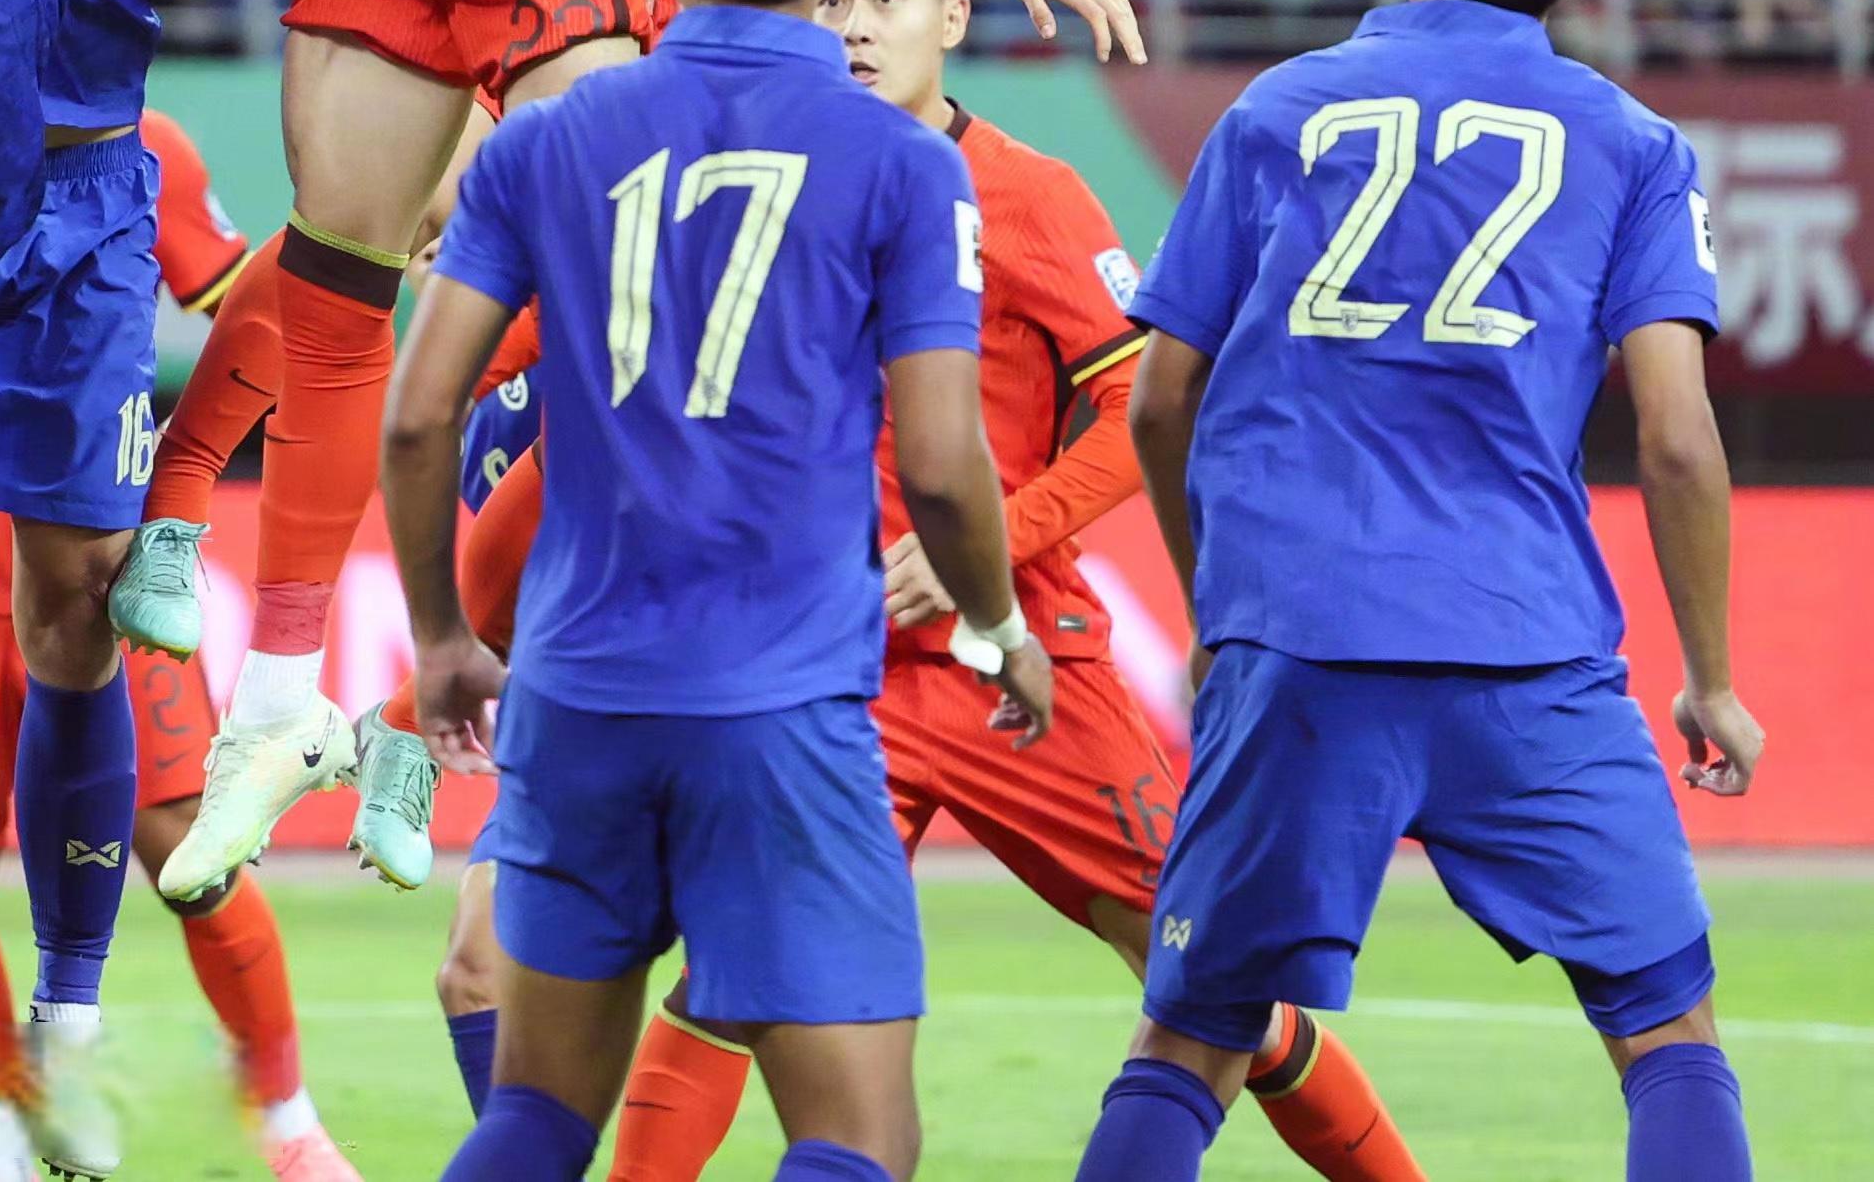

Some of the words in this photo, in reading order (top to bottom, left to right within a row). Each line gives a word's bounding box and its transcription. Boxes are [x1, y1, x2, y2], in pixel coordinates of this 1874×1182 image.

[606, 147, 809, 420] 17
[1288, 96, 1566, 348] 22
[115, 391, 155, 487] 16
